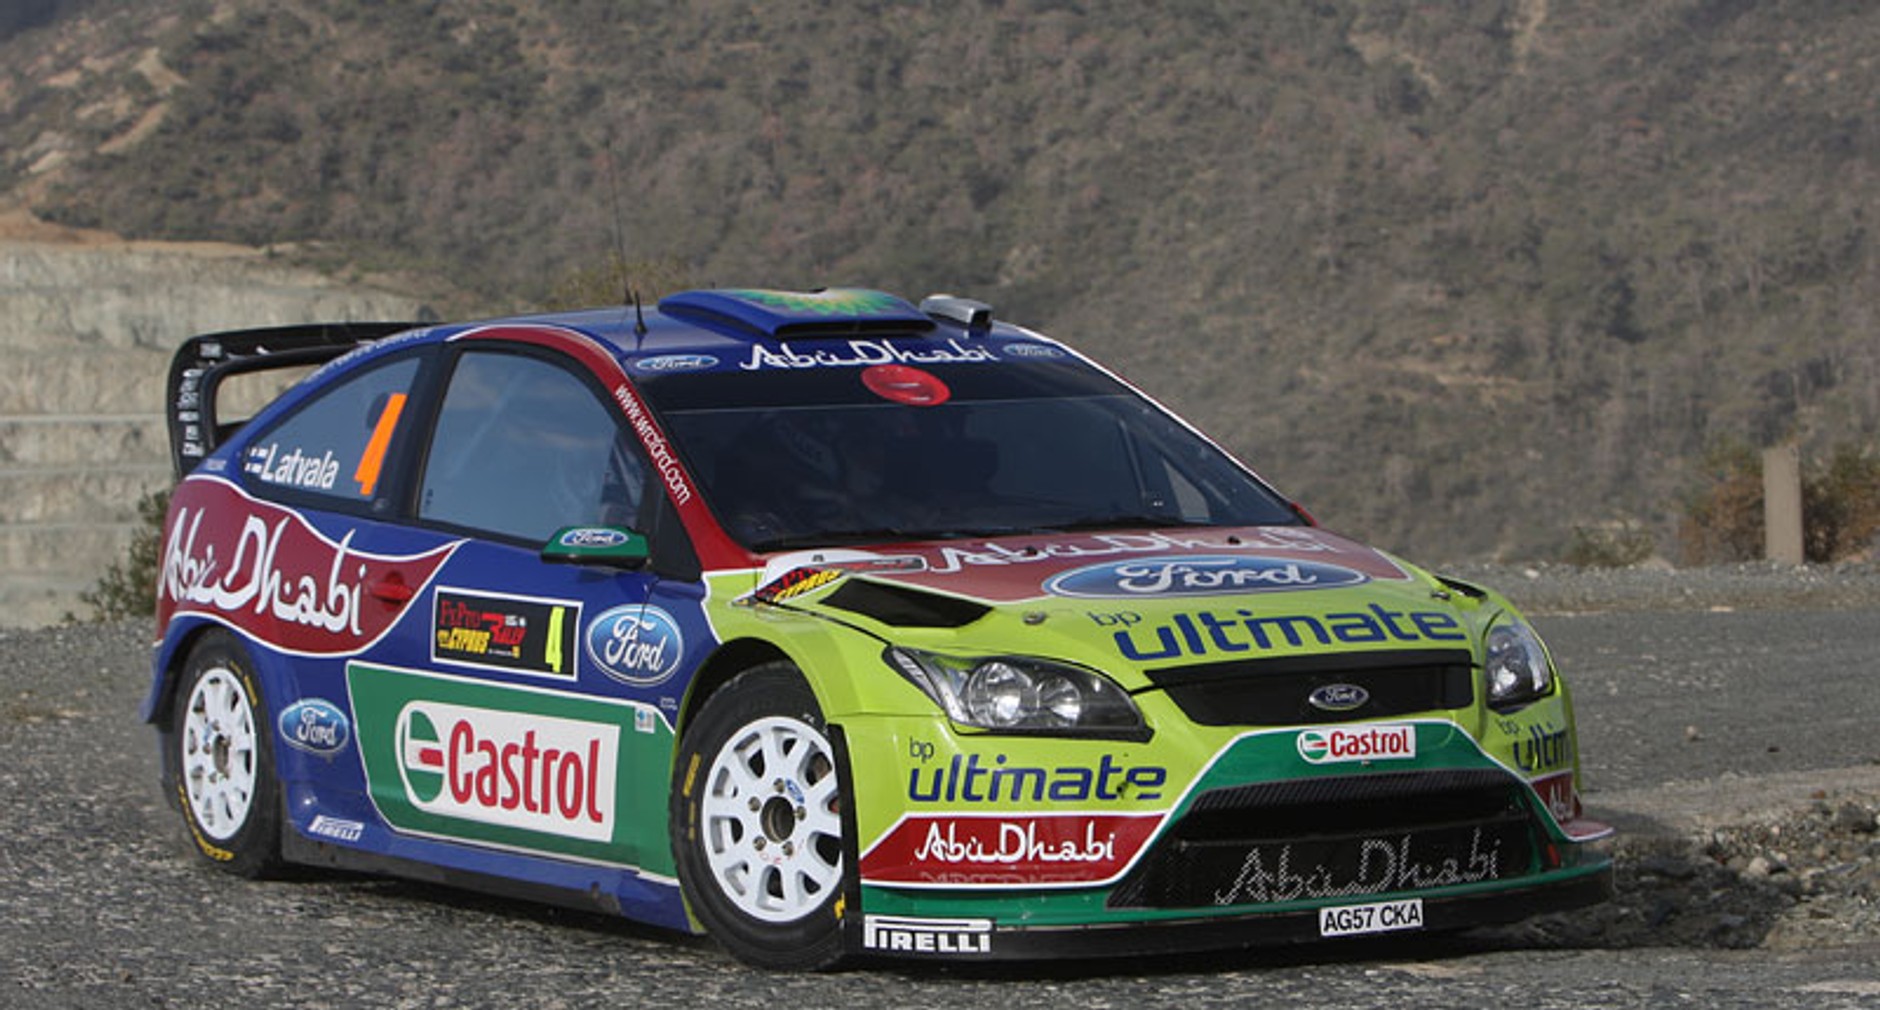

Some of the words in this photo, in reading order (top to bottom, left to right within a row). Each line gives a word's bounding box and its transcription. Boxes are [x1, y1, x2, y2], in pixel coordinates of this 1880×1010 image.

[261, 443, 340, 490] Latvala
[353, 393, 408, 496] 4
[615, 384, 691, 507] www.wrcford.com
[1115, 558, 1318, 594] Ford
[545, 606, 566, 674] 4
[1090, 611, 1142, 628] bp
[1114, 602, 1467, 662] ultimate
[603, 615, 668, 672] Ford
[295, 706, 337, 747] Ford
[909, 737, 935, 763] bp
[1330, 728, 1411, 757] Castrol
[450, 719, 604, 824] Castrol
[908, 753, 1167, 802] ultimate
[864, 914, 994, 952] PIRELLI
[1323, 907, 1375, 932] AG57
[1380, 902, 1421, 926] CKA
